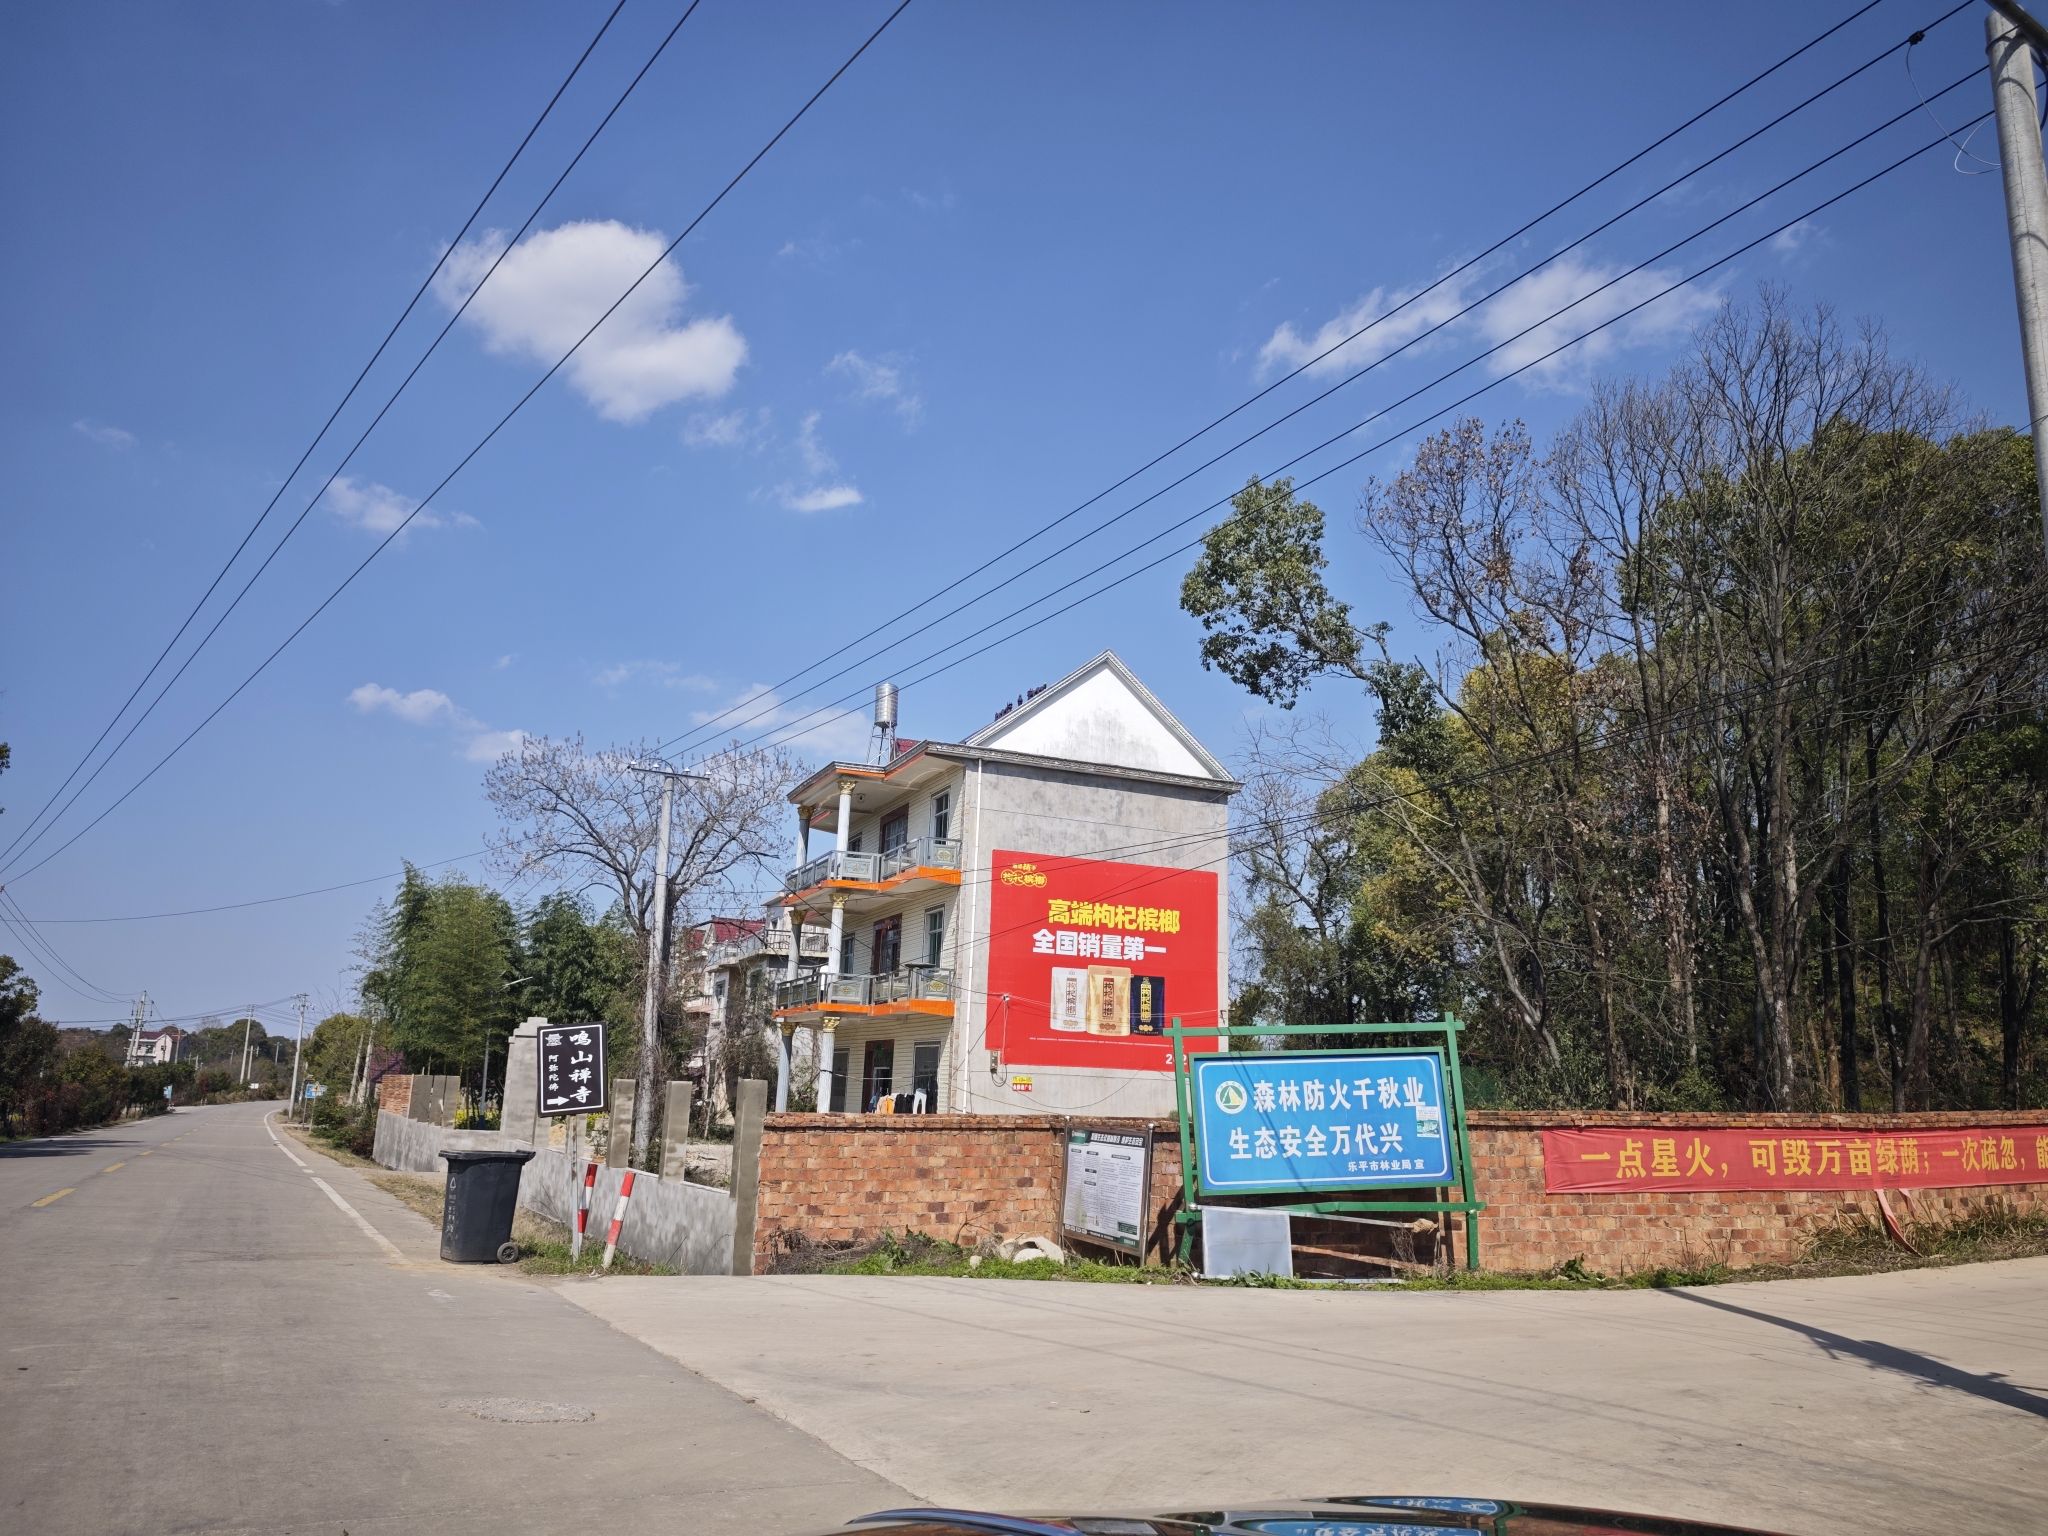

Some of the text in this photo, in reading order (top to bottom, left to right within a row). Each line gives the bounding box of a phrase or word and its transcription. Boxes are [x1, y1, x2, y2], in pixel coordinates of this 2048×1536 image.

[1047, 898, 1181, 935] 高端枸杞槟榔
[1032, 928, 1167, 961] 全国销量第一
[1252, 1076, 1426, 1113] 森林防火千秋业
[1229, 1122, 1404, 1160] 生态安全万代兴
